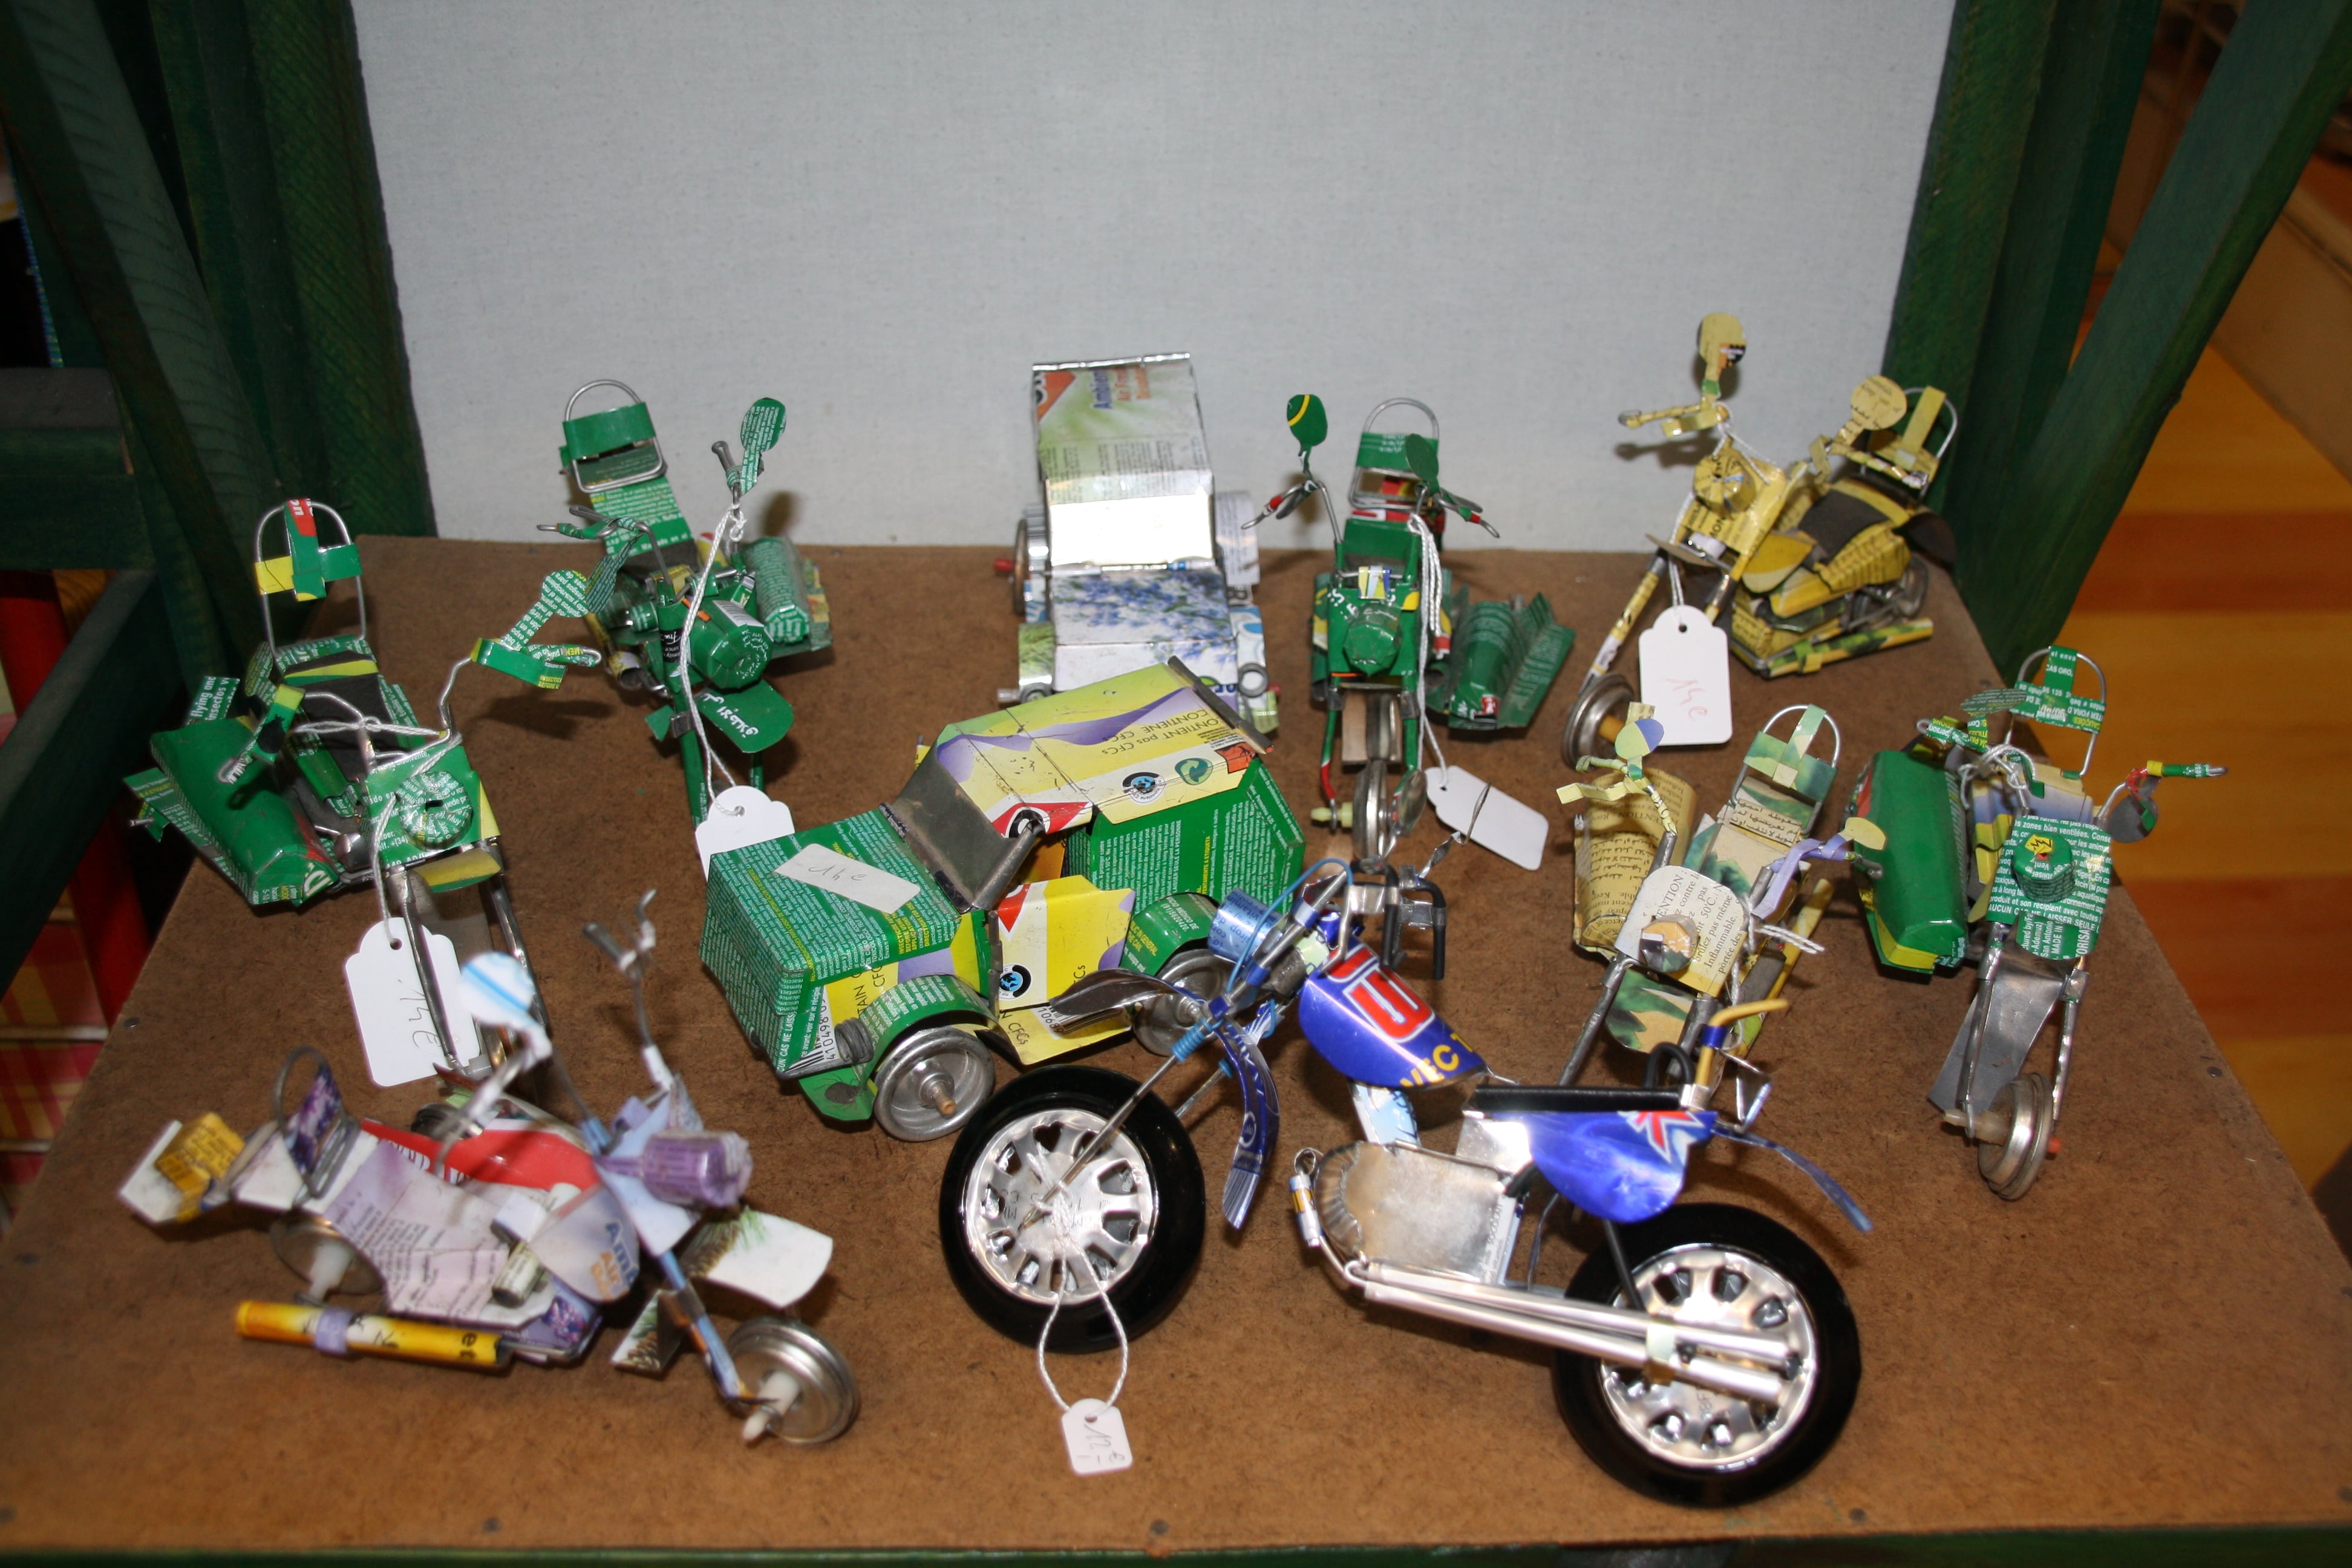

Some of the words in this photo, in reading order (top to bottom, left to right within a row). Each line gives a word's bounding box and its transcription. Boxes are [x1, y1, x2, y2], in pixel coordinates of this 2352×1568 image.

[204, 685, 228, 723] insectos
[1141, 707, 1208, 735] CONTIENE
[1162, 714, 1220, 741] ONTIENT
[1100, 740, 1135, 758] CFCs
[1135, 733, 1158, 746] pas
[2022, 821, 2042, 830] zones
[2043, 824, 2057, 832] bien
[2059, 826, 2089, 838] ventilées.
[1655, 873, 1684, 918] ENTION
[1677, 878, 1696, 907] contre
[1695, 884, 1708, 901] pas
[1713, 893, 1733, 921] même
[2019, 899, 2031, 907] son
[2063, 907, 2078, 915] avec
[2079, 910, 2098, 921] toutes
[1707, 920, 1720, 936] pas
[2041, 920, 2054, 944] Antonio
[2073, 918, 2095, 931] SEULE
[1703, 912, 1737, 969] Inflammable.
[2040, 944, 2050, 957] San
[2050, 933, 2062, 954] MADE
[1716, 947, 1735, 975] portée
[1728, 930, 1742, 947] des
[783, 1032, 791, 1042] NE
[779, 1043, 789, 1057] CAS
